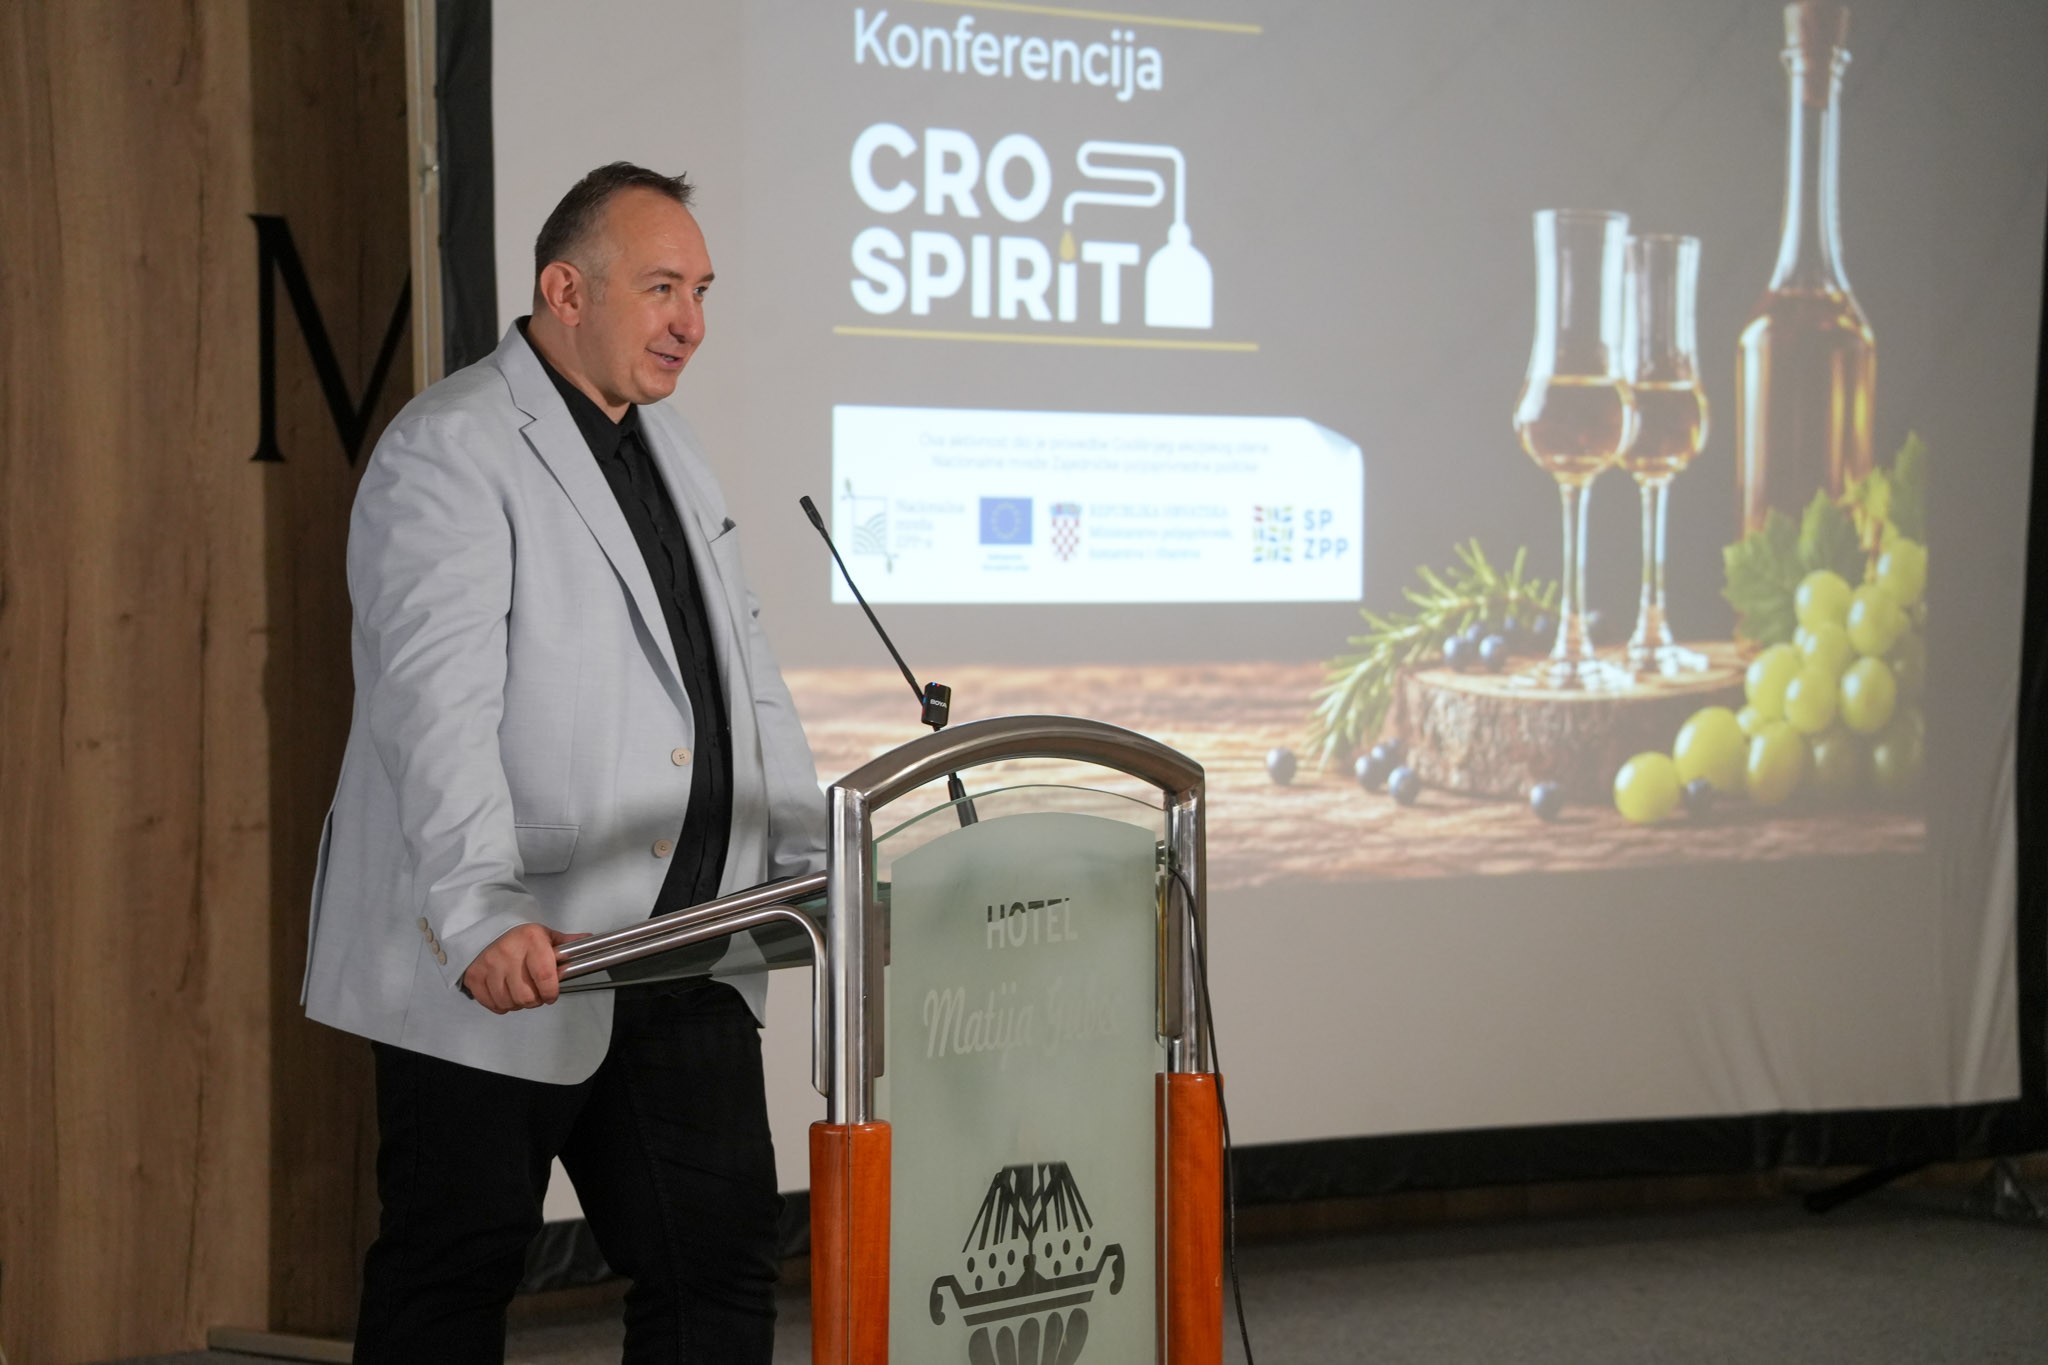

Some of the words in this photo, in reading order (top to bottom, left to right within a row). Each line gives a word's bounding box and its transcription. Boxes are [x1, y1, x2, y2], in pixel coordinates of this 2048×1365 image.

[854, 8, 1163, 102] Konferencija
[850, 122, 1052, 223] CRO
[247, 213, 413, 468] M
[1303, 508, 1333, 531] SP
[1303, 536, 1349, 560] ZPP
[930, 698, 948, 709] BOYA
[986, 897, 1078, 950] HOTEL
[923, 980, 1035, 1072] Matija
